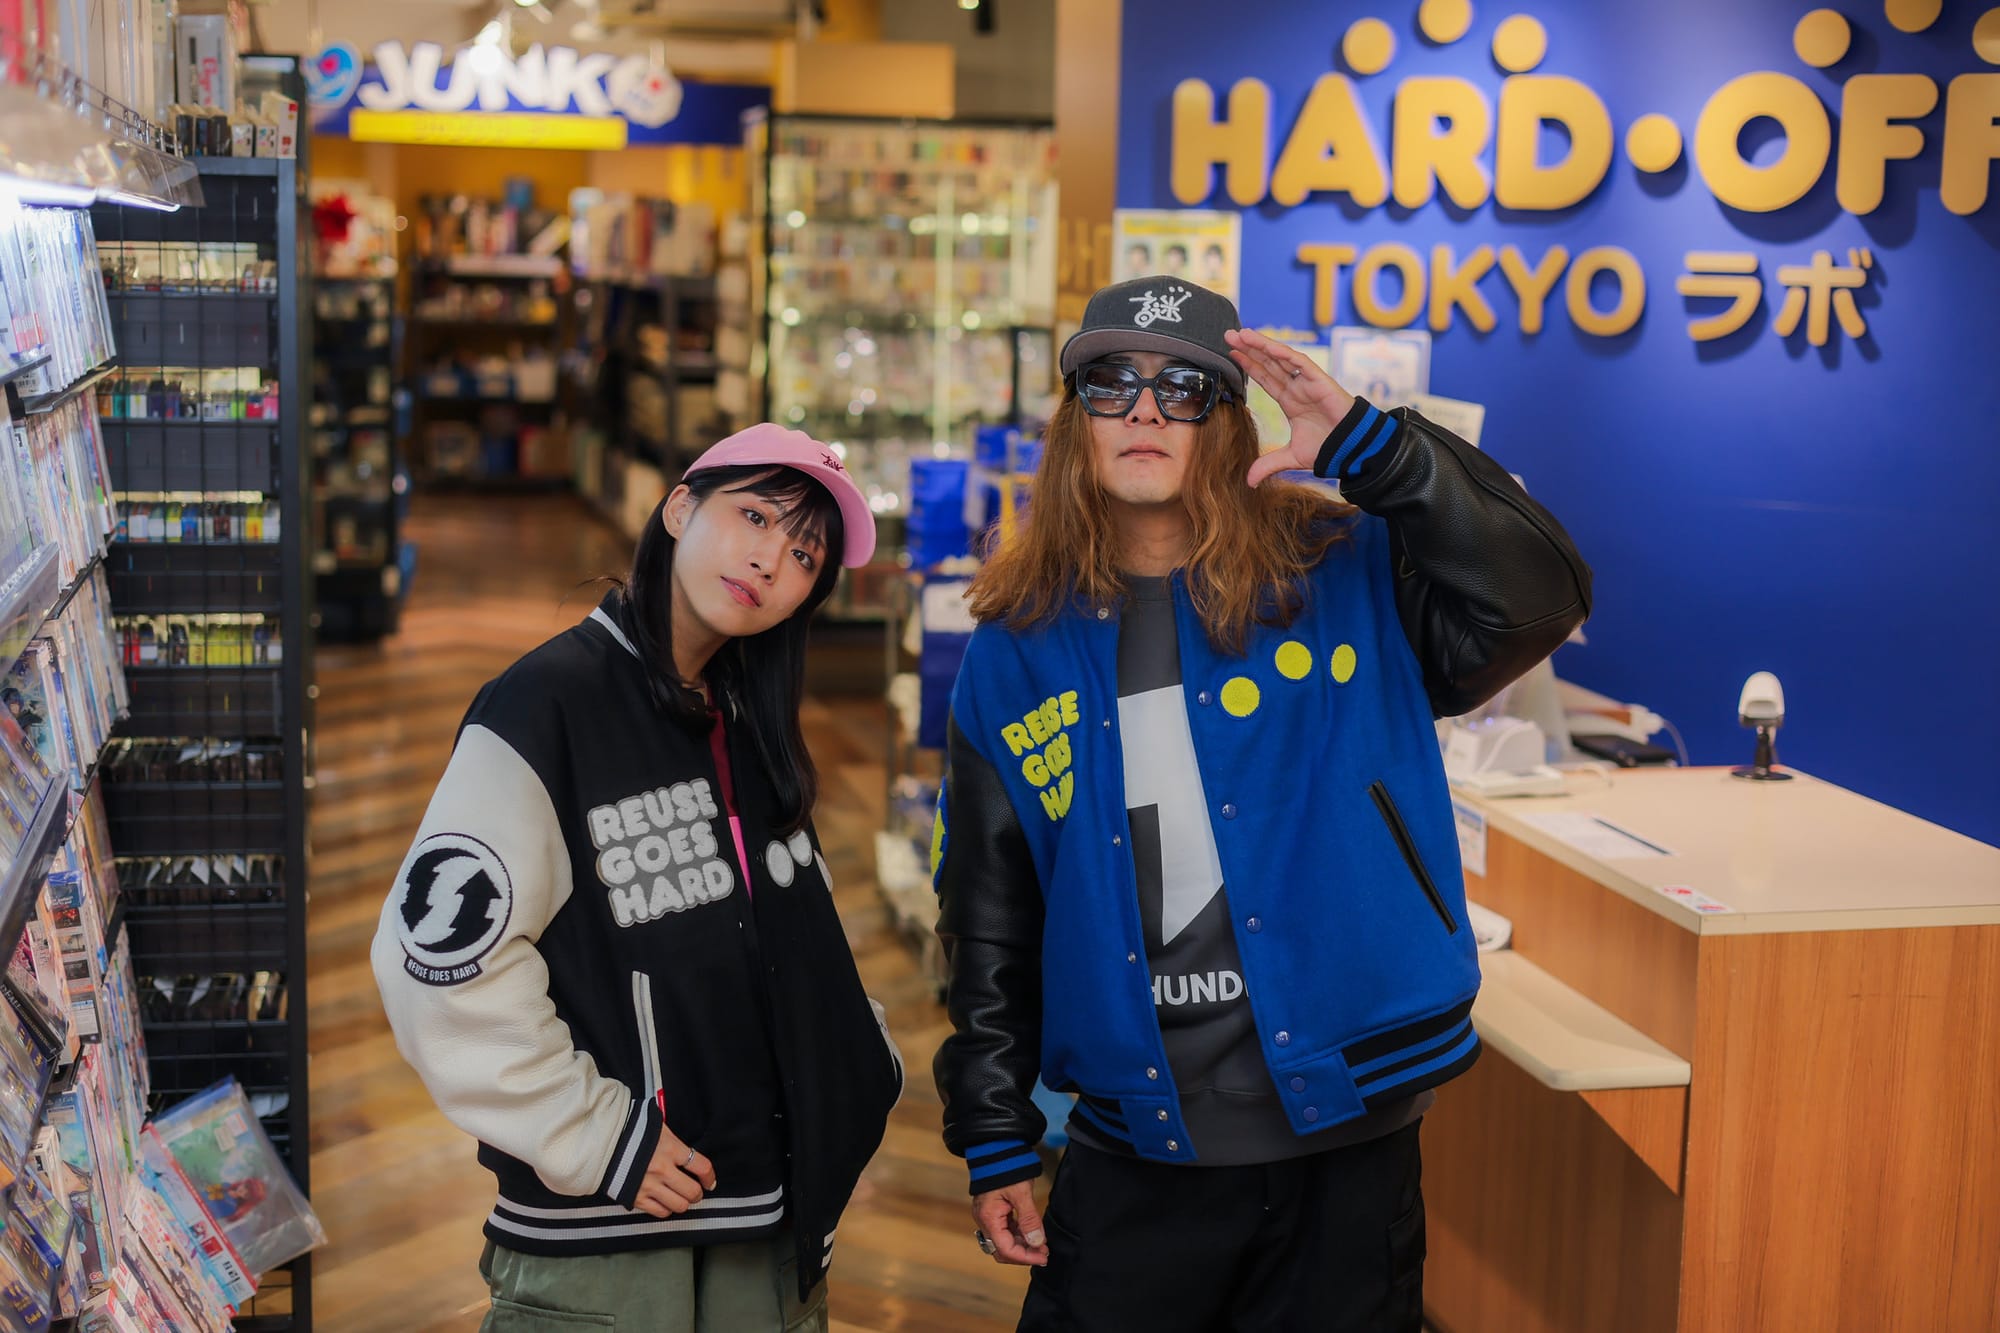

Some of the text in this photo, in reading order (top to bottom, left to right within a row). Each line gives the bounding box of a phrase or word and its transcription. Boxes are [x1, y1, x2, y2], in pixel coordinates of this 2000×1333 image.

[357, 39, 620, 117] JUNK
[1297, 243, 1873, 346] TOKYO ラボ
[590, 778, 718, 846] REUSE
[599, 821, 716, 885] GOES
[610, 860, 733, 926] HARD
[407, 959, 478, 982] REUSE GOES HARD
